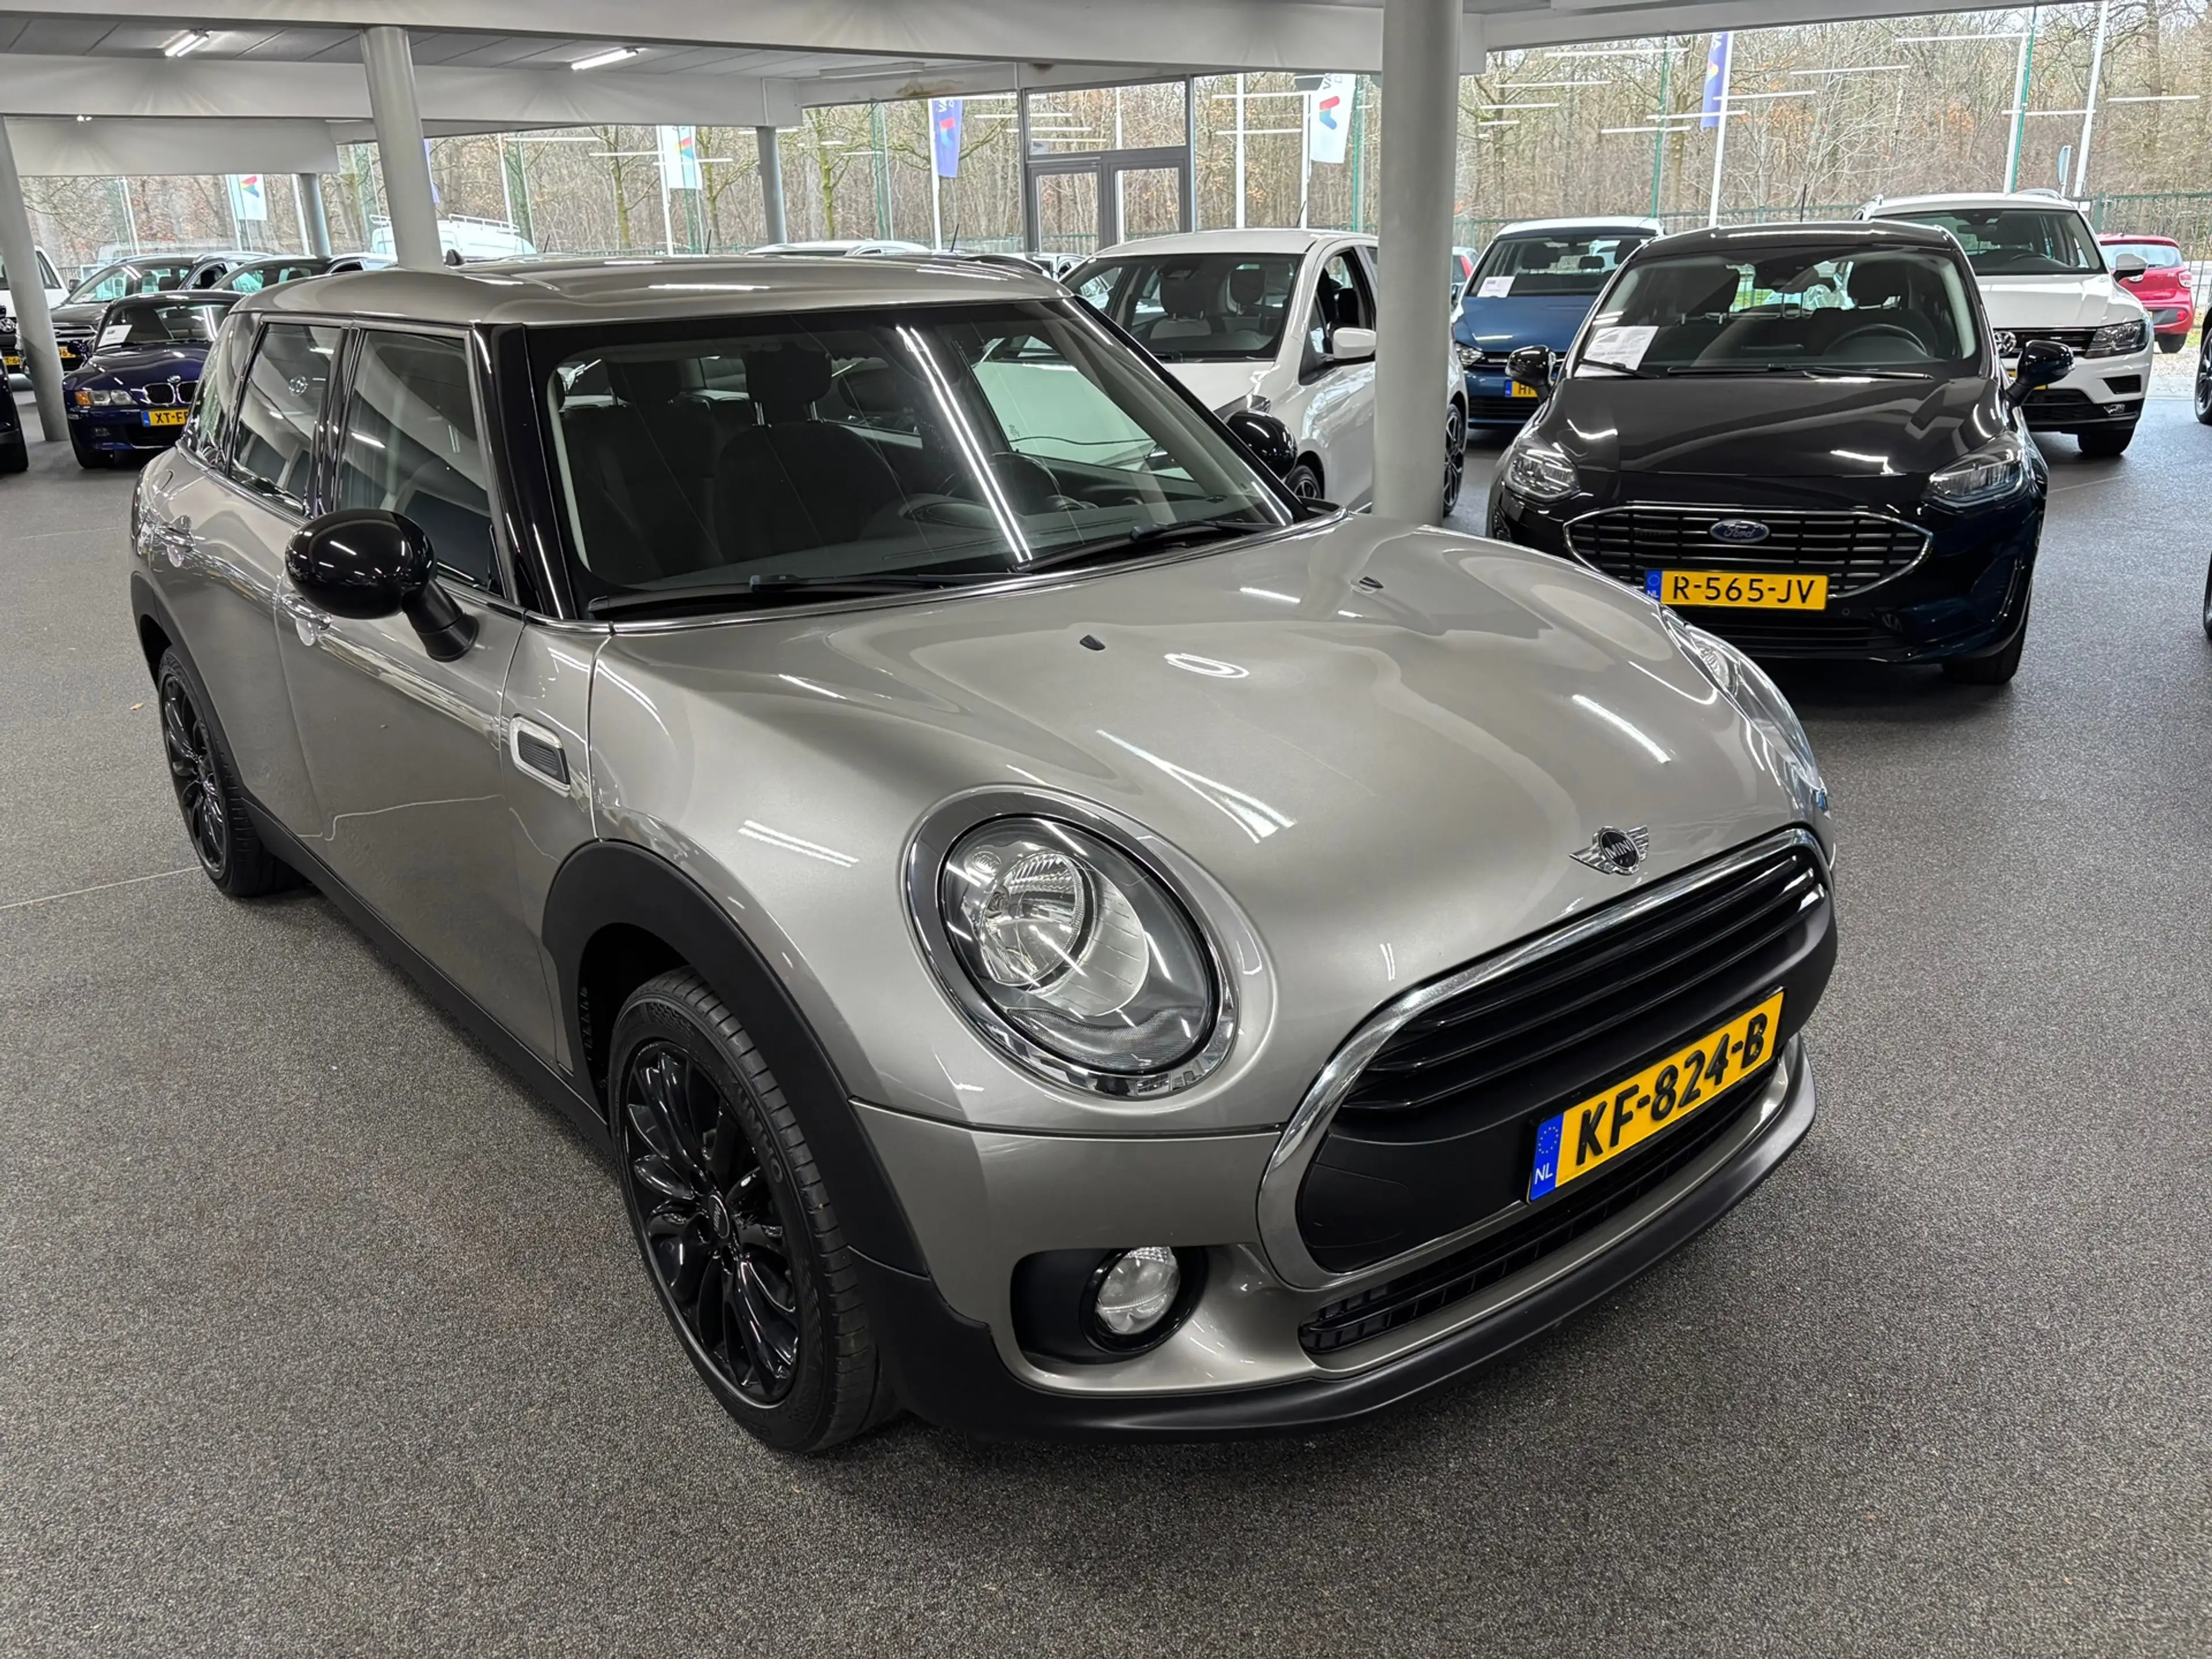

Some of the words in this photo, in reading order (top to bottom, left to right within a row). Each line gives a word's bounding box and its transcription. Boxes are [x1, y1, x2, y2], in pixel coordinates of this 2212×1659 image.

[1647, 590, 1659, 598] NL
[1672, 575, 1815, 604] R-565-JV
[1605, 839, 1633, 859] MINI
[1575, 1013, 1768, 1166] KF-824-B
[1534, 1162, 1554, 1185] NL
